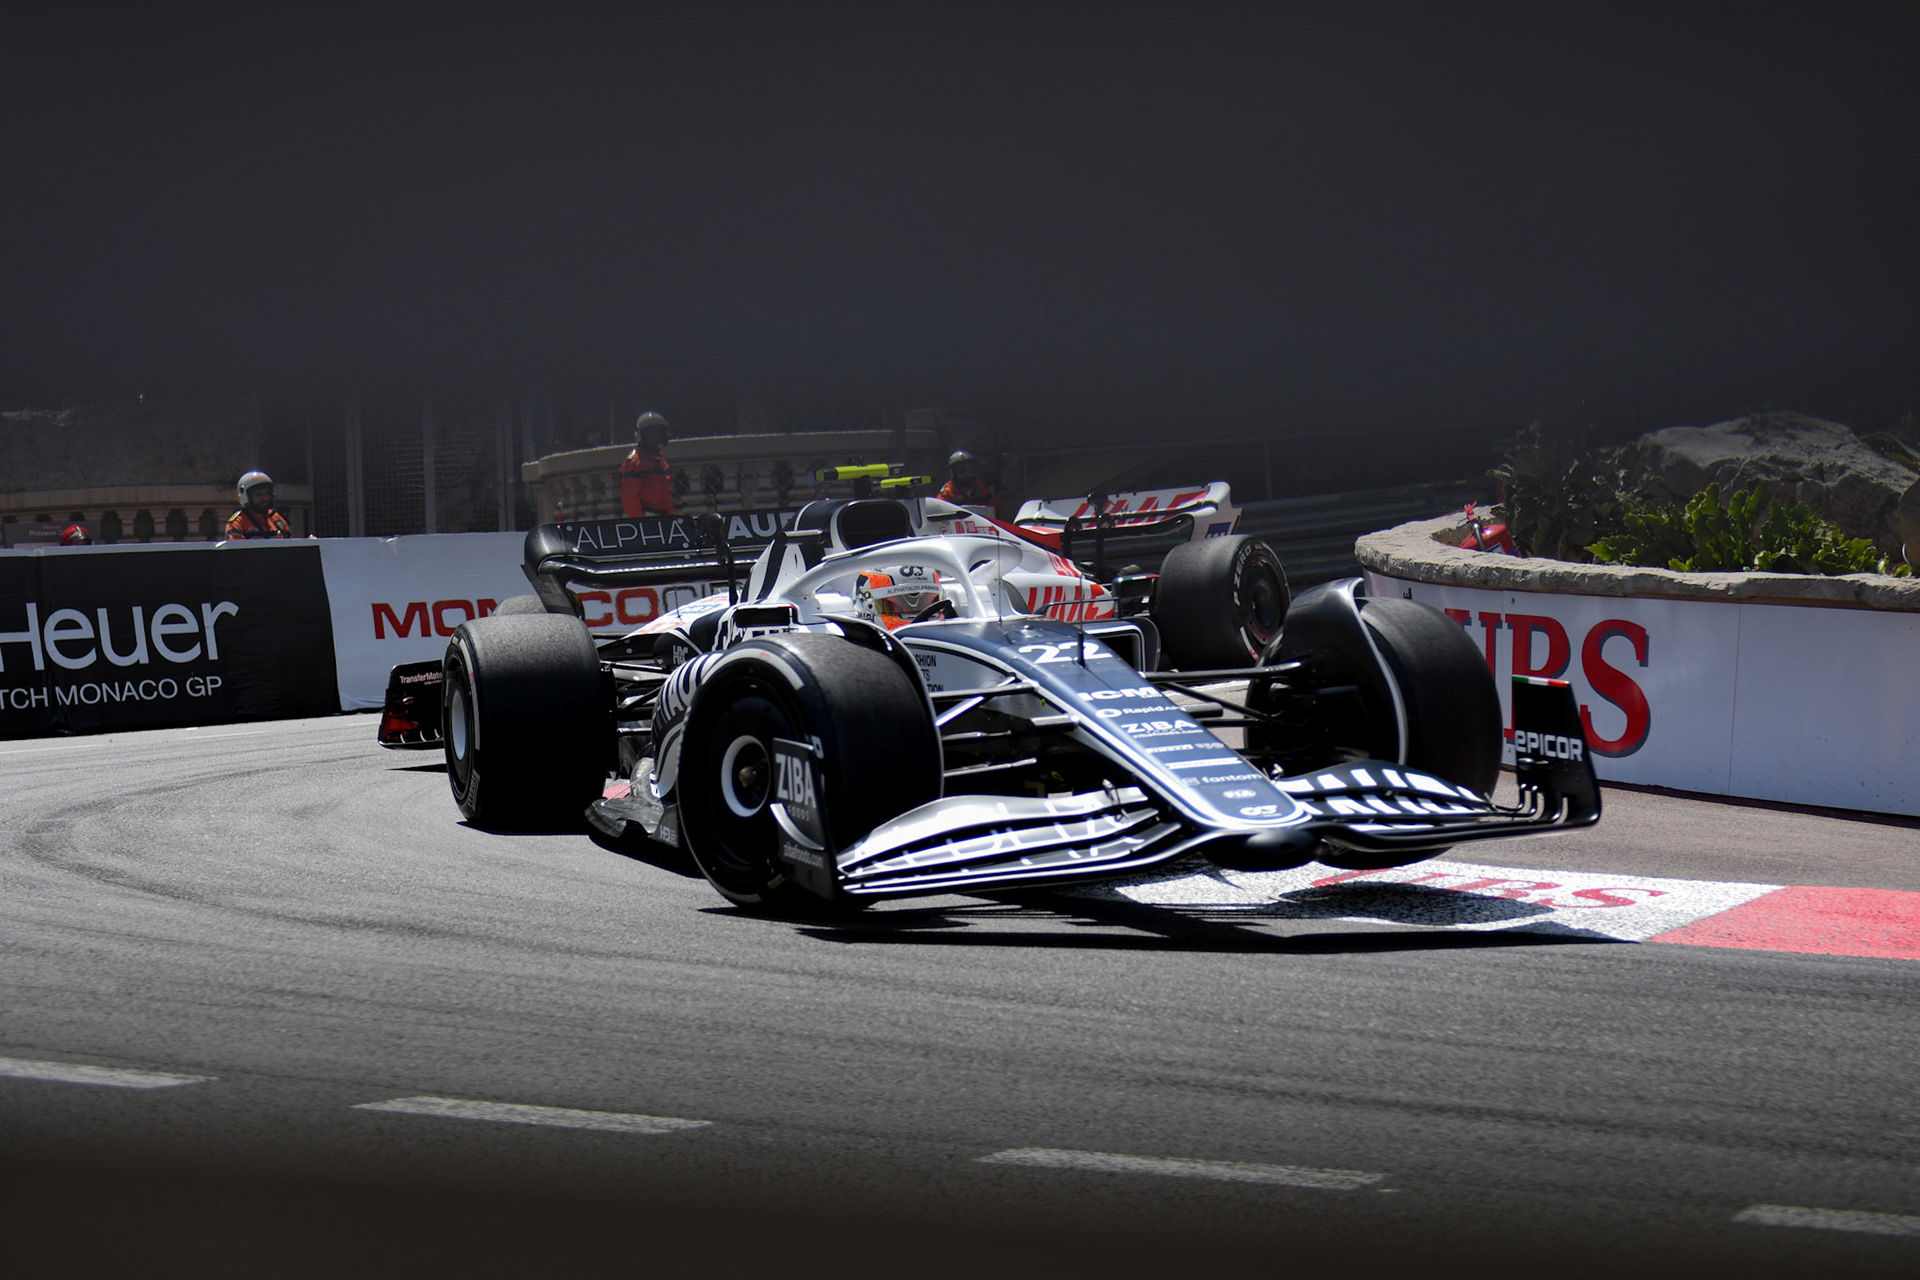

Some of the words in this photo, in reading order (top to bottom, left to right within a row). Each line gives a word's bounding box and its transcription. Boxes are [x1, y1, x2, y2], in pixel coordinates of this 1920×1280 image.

[577, 521, 690, 549] ALPHA
[371, 587, 660, 640] MOCO
[1018, 641, 1113, 665] 22
[54, 677, 178, 705] MONACO
[186, 674, 223, 697] GP
[399, 671, 444, 685] TransferMate
[1076, 686, 1162, 702] ICM
[1121, 719, 1198, 734] ZIBA
[775, 753, 818, 809] ZIBA
[1202, 773, 1264, 784] fantom
